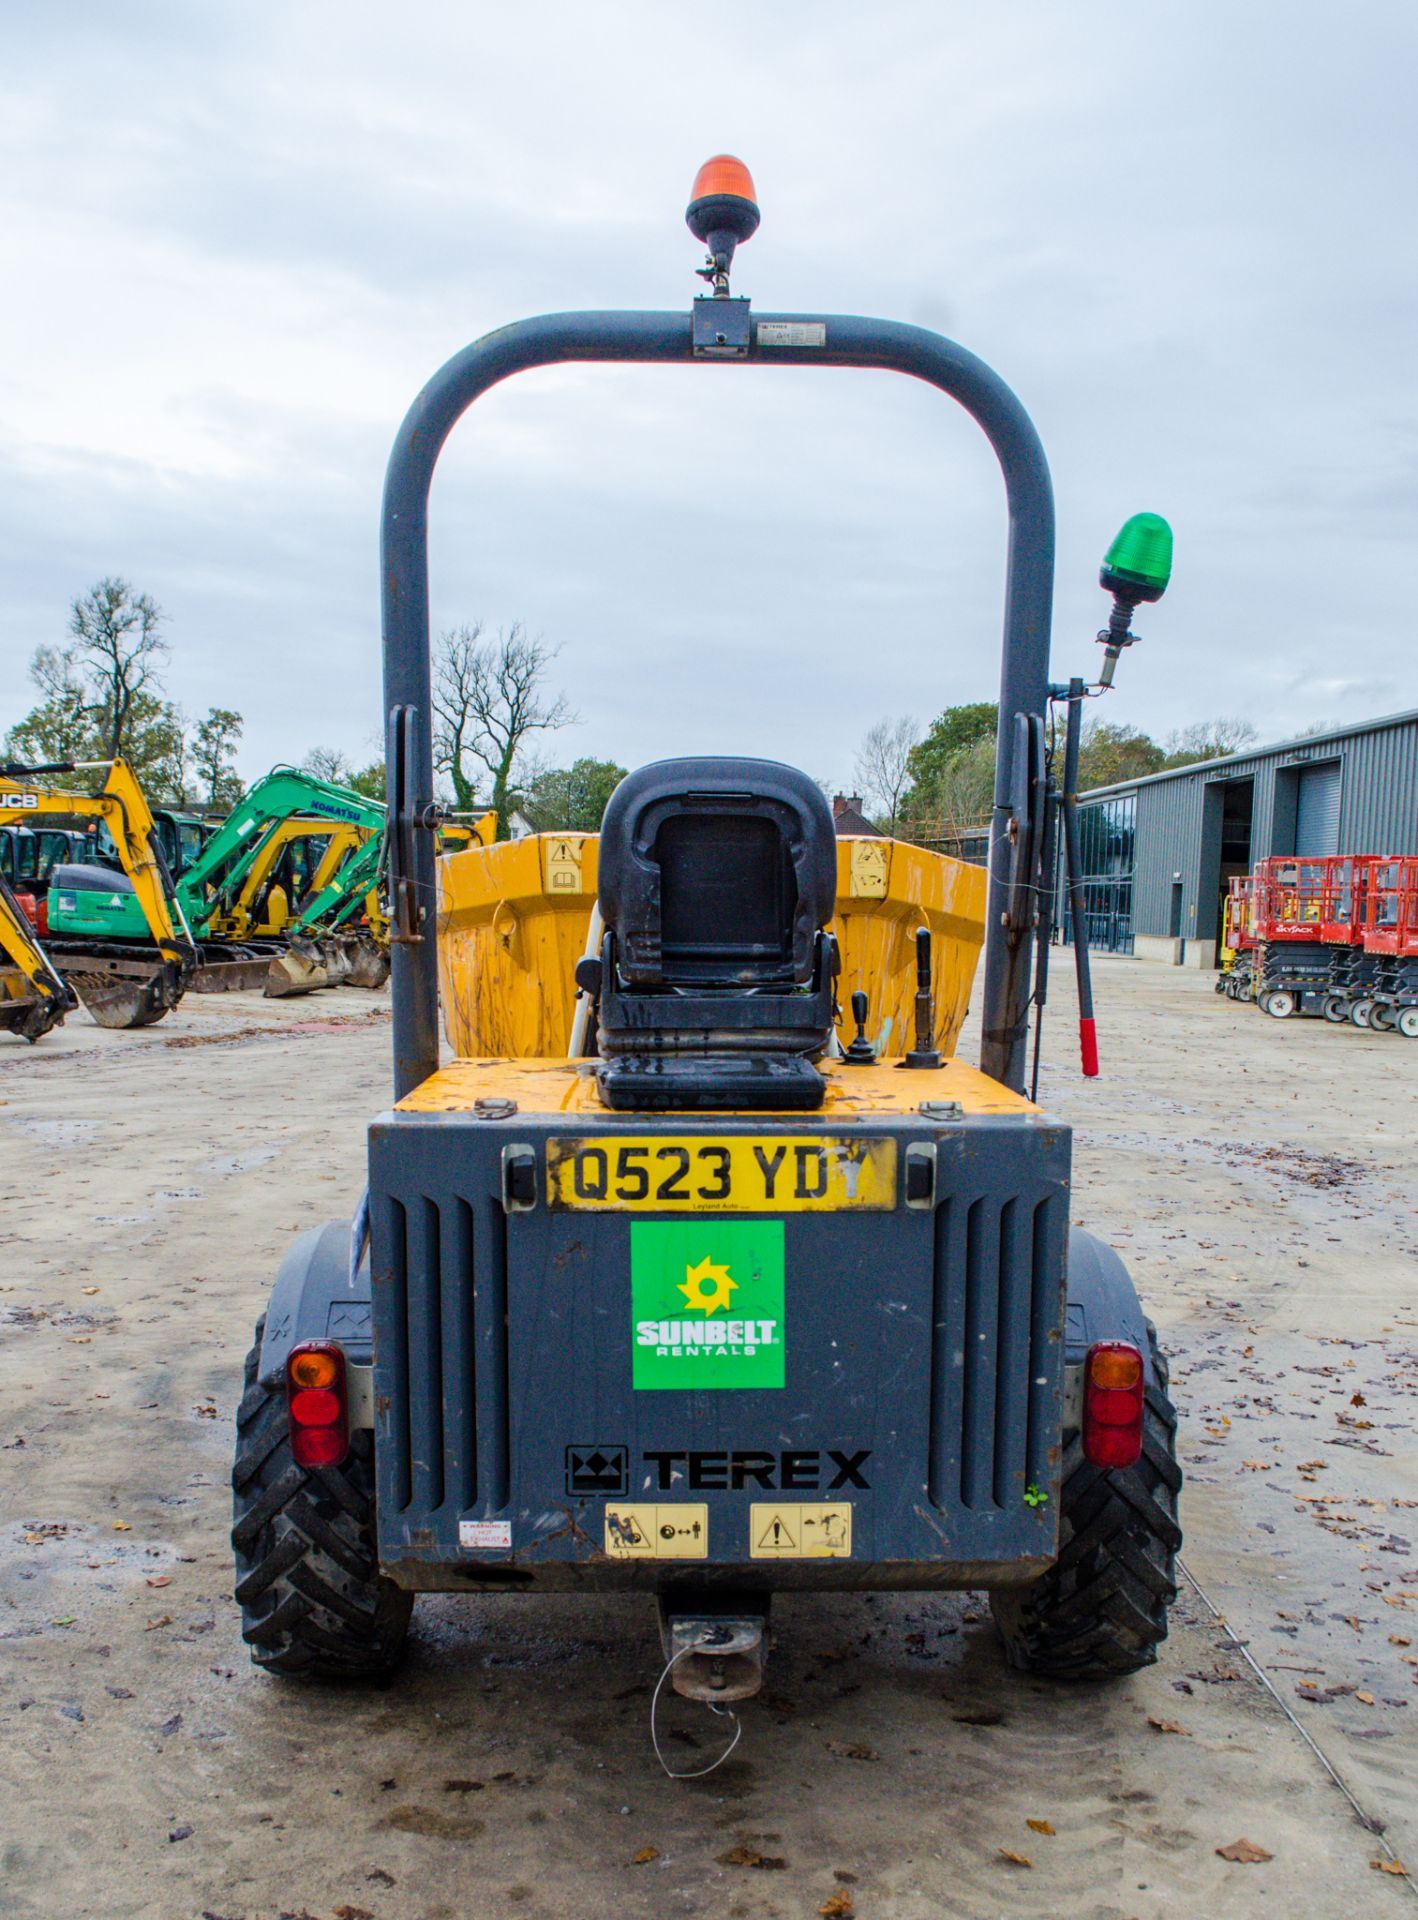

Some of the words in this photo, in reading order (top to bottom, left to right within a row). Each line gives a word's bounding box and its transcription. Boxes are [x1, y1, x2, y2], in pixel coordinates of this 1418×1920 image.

[0, 793, 38, 808] JCB
[1275, 924, 1313, 934] SKYJACK
[573, 1147, 732, 1201] Q523
[752, 1145, 867, 1199] YDY
[636, 1320, 777, 1346] SUNBELT
[656, 1346, 757, 1357] RENTALS
[643, 1451, 872, 1490] TEREX
